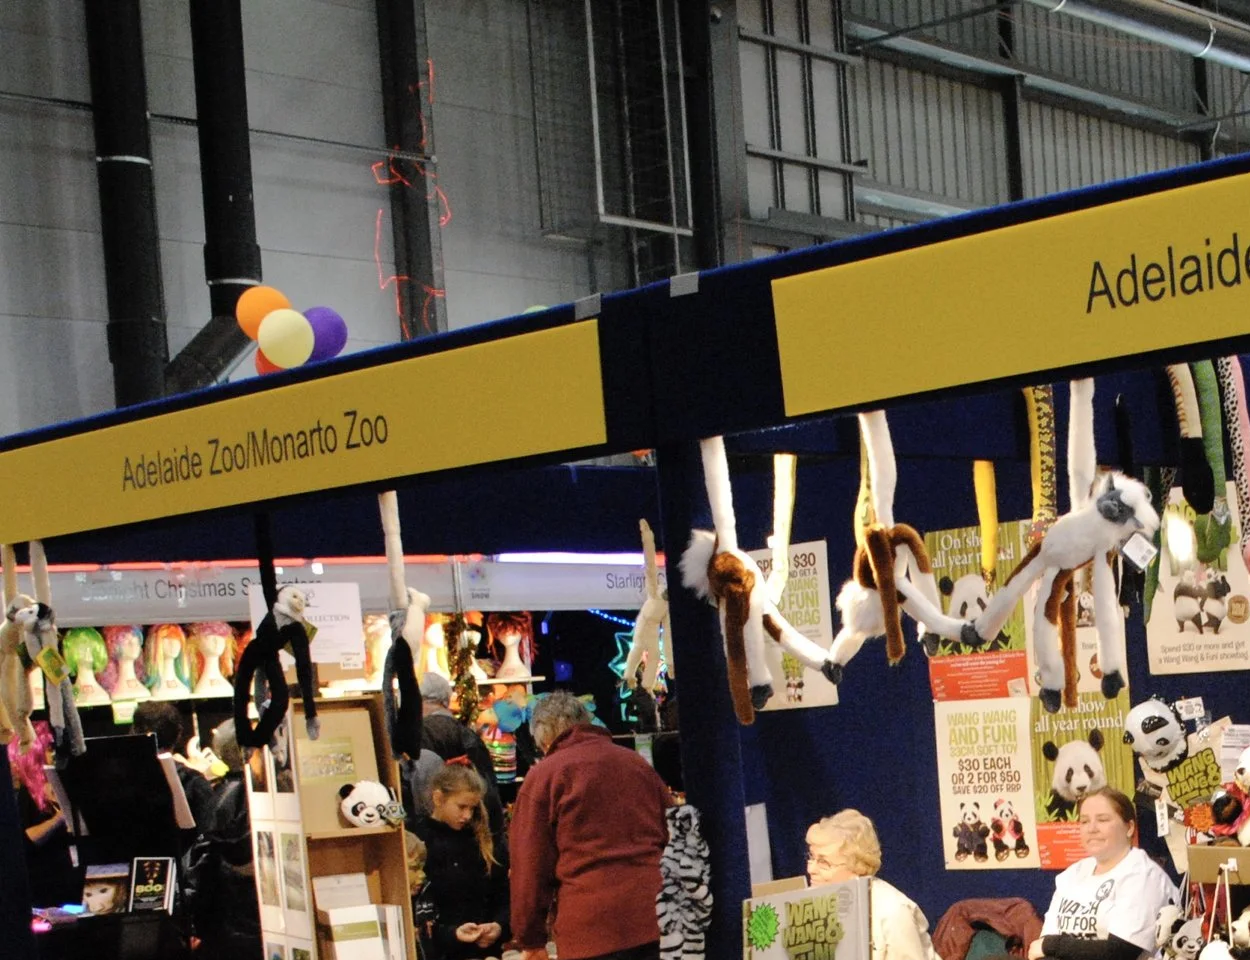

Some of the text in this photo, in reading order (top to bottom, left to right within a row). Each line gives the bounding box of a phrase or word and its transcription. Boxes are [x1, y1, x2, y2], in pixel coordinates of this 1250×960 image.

[122, 410, 388, 492] Adelaide Zoo/Monarto Zoo
[941, 534, 960, 552] On
[793, 552, 816, 569] $30
[931, 550, 946, 569] all
[948, 552, 974, 573] year
[154, 578, 236, 600] Christmas
[606, 571, 646, 592] Starlig
[788, 591, 820, 611] FUNI
[947, 707, 1017, 727] WANG WANG
[1035, 710, 1123, 737] all year round
[949, 724, 1017, 746] AND FUNI
[976, 744, 999, 757] SOFT
[1001, 743, 1018, 755] TOY
[958, 755, 1012, 772] $30 EACH
[1166, 746, 1216, 786] WANG
[951, 769, 1021, 785] OR 2 FOR $50
[1166, 770, 1207, 798] WANG
[952, 784, 971, 796] SAVE
[972, 784, 989, 795] $20
[990, 783, 1004, 794] OFF
[784, 894, 839, 926] WANG
[1073, 915, 1098, 932] FOR
[782, 919, 826, 950] WANG
